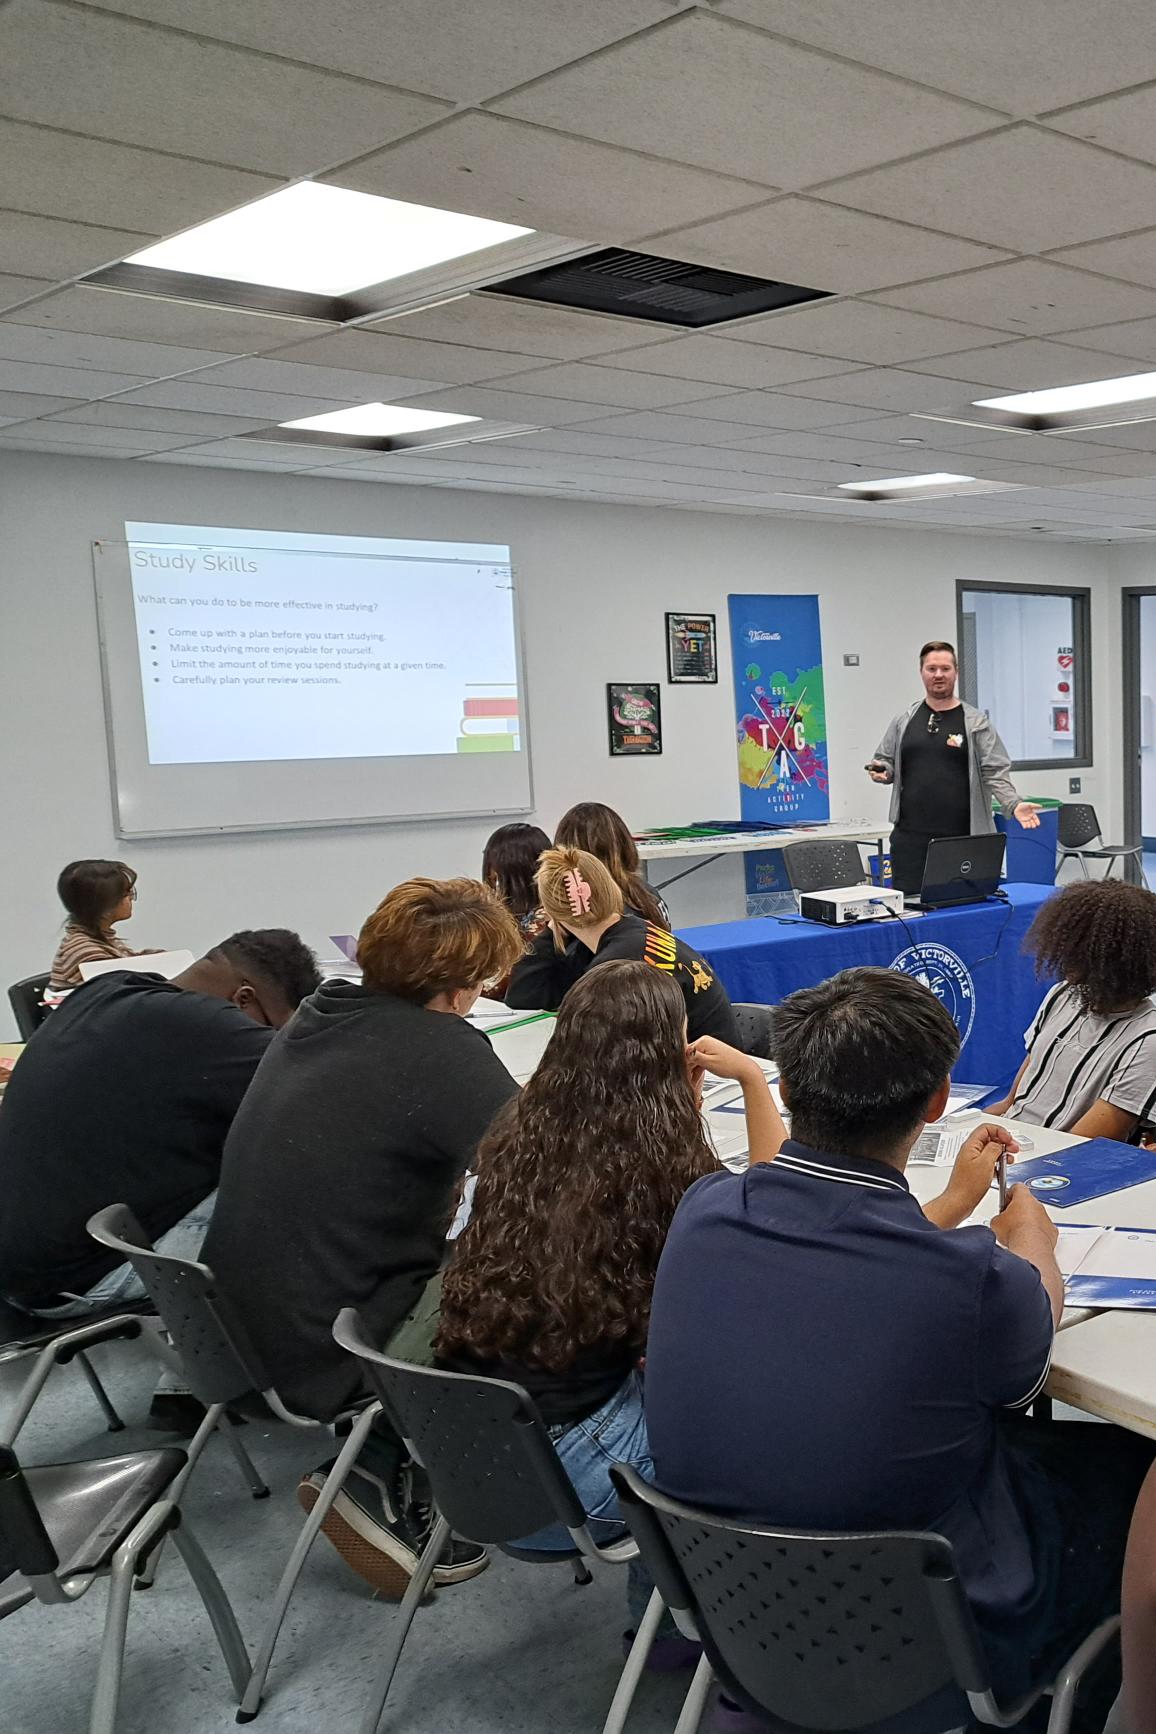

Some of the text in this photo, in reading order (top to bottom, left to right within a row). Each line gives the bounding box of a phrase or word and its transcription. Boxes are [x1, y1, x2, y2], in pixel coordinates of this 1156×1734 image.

[134, 550, 258, 573] Study Skills
[137, 595, 167, 604] What
[211, 598, 224, 606] do
[226, 599, 237, 607] to
[239, 598, 252, 607] be
[254, 600, 280, 608] more
[282, 600, 322, 609] effective
[324, 601, 333, 609] in
[336, 602, 378, 612] studying?
[168, 628, 198, 637] Come
[200, 630, 213, 638] up
[216, 629, 237, 637] with
[248, 630, 269, 639] plan
[271, 630, 302, 639] before
[324, 632, 345, 640] start
[346, 632, 388, 642] studying.
[170, 644, 198, 652] Make
[200, 645, 243, 655] studying
[272, 646, 318, 655] enjoyable
[320, 646, 333, 654] for
[336, 647, 374, 655] yourself.
[682, 640, 704, 652] YET
[171, 660, 197, 668] Limit
[199, 660, 215, 668] the
[218, 661, 256, 669] amount
[258, 660, 268, 669] of
[270, 661, 292, 669] time
[295, 662, 312, 670] you
[315, 661, 342, 670] spend
[344, 662, 382, 671] studying
[400, 663, 423, 671] given
[425, 662, 447, 670] time.
[172, 676, 217, 685] Carefully
[220, 676, 240, 685] plan
[243, 677, 265, 685] your
[758, 722, 805, 751] T G
[780, 750, 791, 778] A
[911, 949, 970, 998] VICTORVILLE
